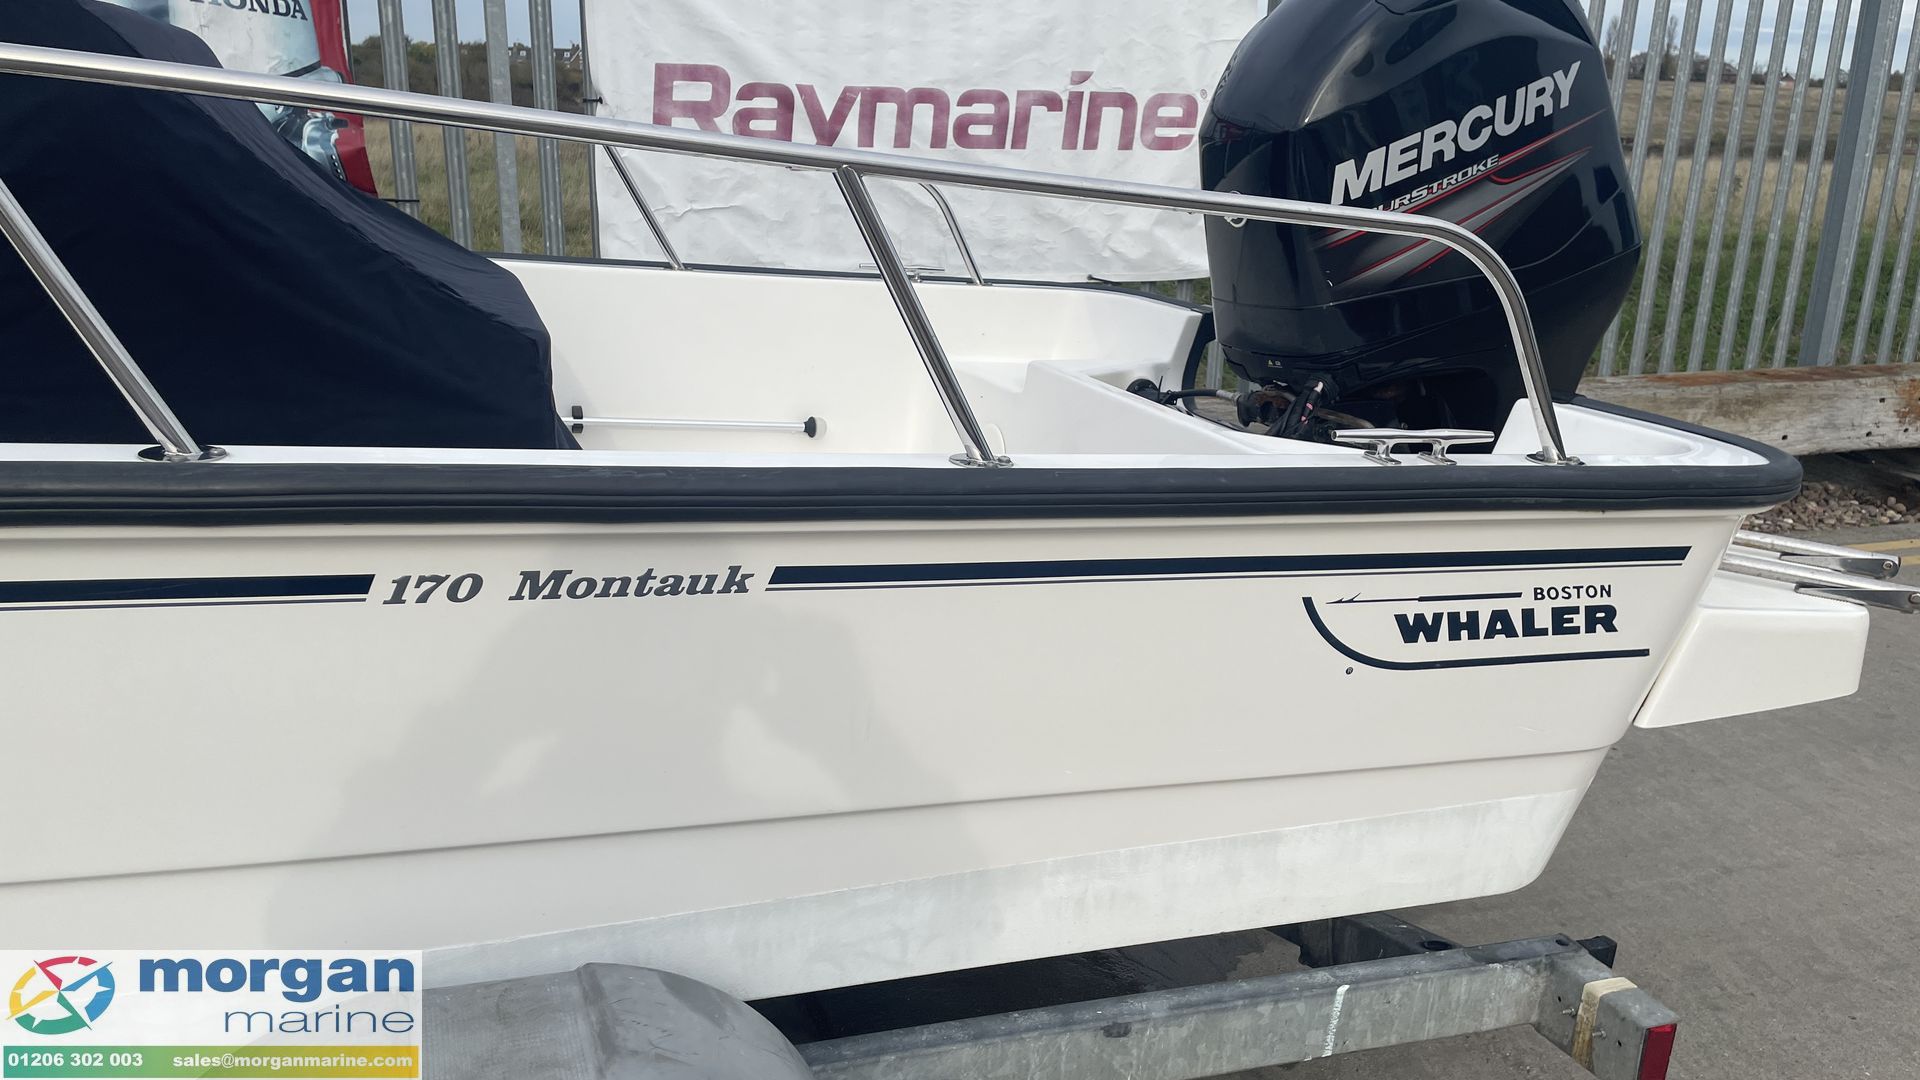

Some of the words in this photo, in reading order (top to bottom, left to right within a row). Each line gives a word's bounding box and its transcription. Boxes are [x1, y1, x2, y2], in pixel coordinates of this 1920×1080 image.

[189, 0, 308, 21] NDA
[653, 63, 1198, 150] Raymarine
[1331, 61, 1581, 205] MERCURY
[1374, 154, 1500, 212] URSTROKE
[382, 573, 484, 604] 170
[508, 565, 755, 600] Montauk
[1533, 585, 1612, 600] BOSTON
[1394, 604, 1618, 643] WHALER
